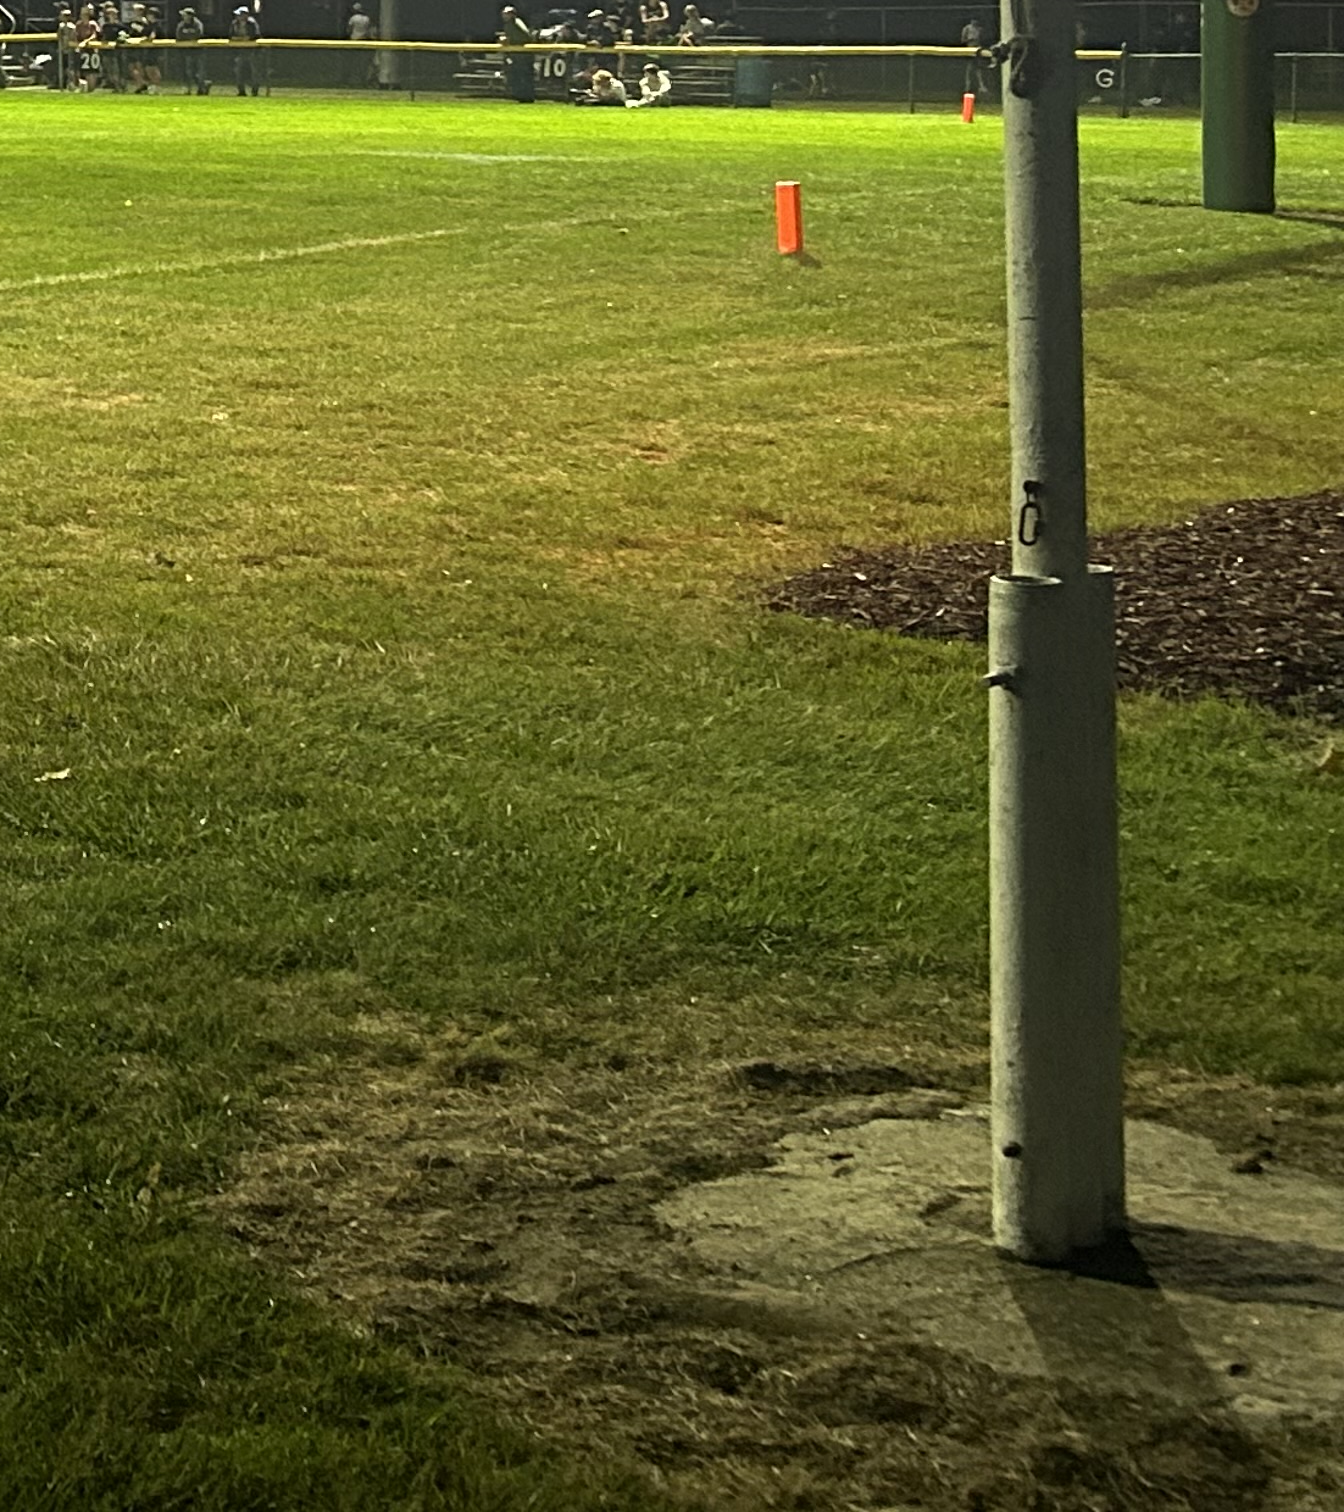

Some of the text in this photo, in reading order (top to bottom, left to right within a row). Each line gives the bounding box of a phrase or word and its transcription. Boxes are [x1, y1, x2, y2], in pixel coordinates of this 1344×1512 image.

[80, 52, 101, 70] 20
[543, 57, 567, 78] 10
[1095, 68, 1115, 88] G
